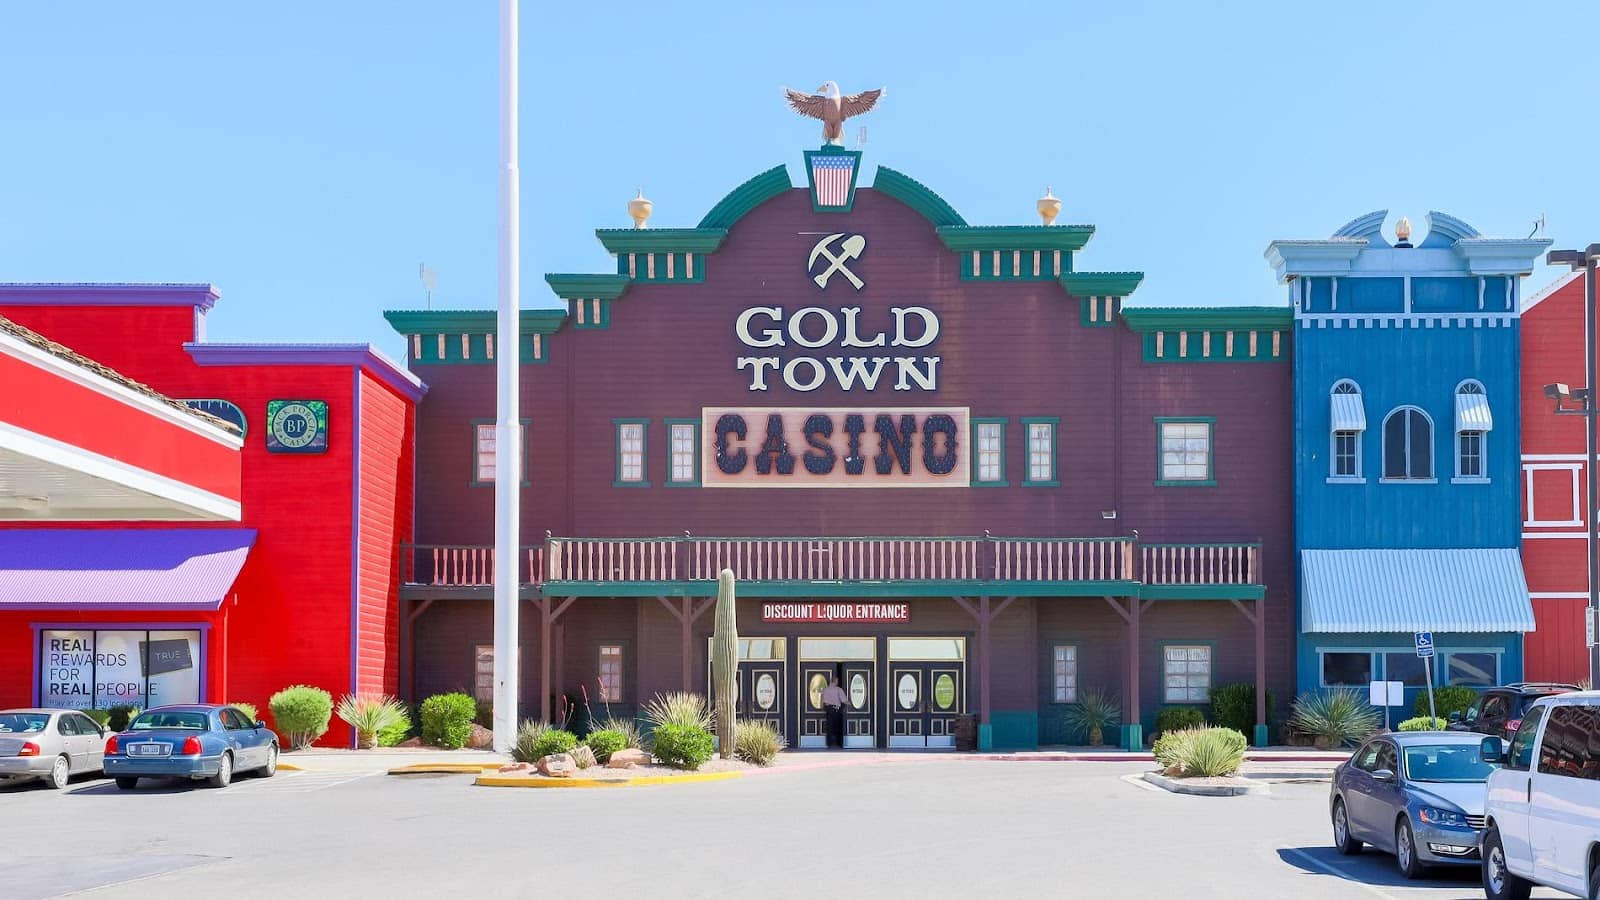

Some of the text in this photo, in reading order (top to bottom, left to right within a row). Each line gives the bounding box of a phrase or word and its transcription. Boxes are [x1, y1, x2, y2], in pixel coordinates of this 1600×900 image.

[735, 306, 940, 348] GOLD
[737, 356, 941, 392] TOWN
[292, 405, 316, 432] PORCH
[286, 419, 305, 433] BP
[714, 414, 958, 475] CASINO
[763, 604, 814, 619] DISCOUNT
[855, 604, 907, 619] ENTRANCE
[50, 639, 92, 652] REAL
[50, 653, 128, 667] REWARDS
[154, 650, 182, 662] TRUE
[50, 668, 80, 681] FOR
[49, 682, 158, 696] REAL PEOPLE
